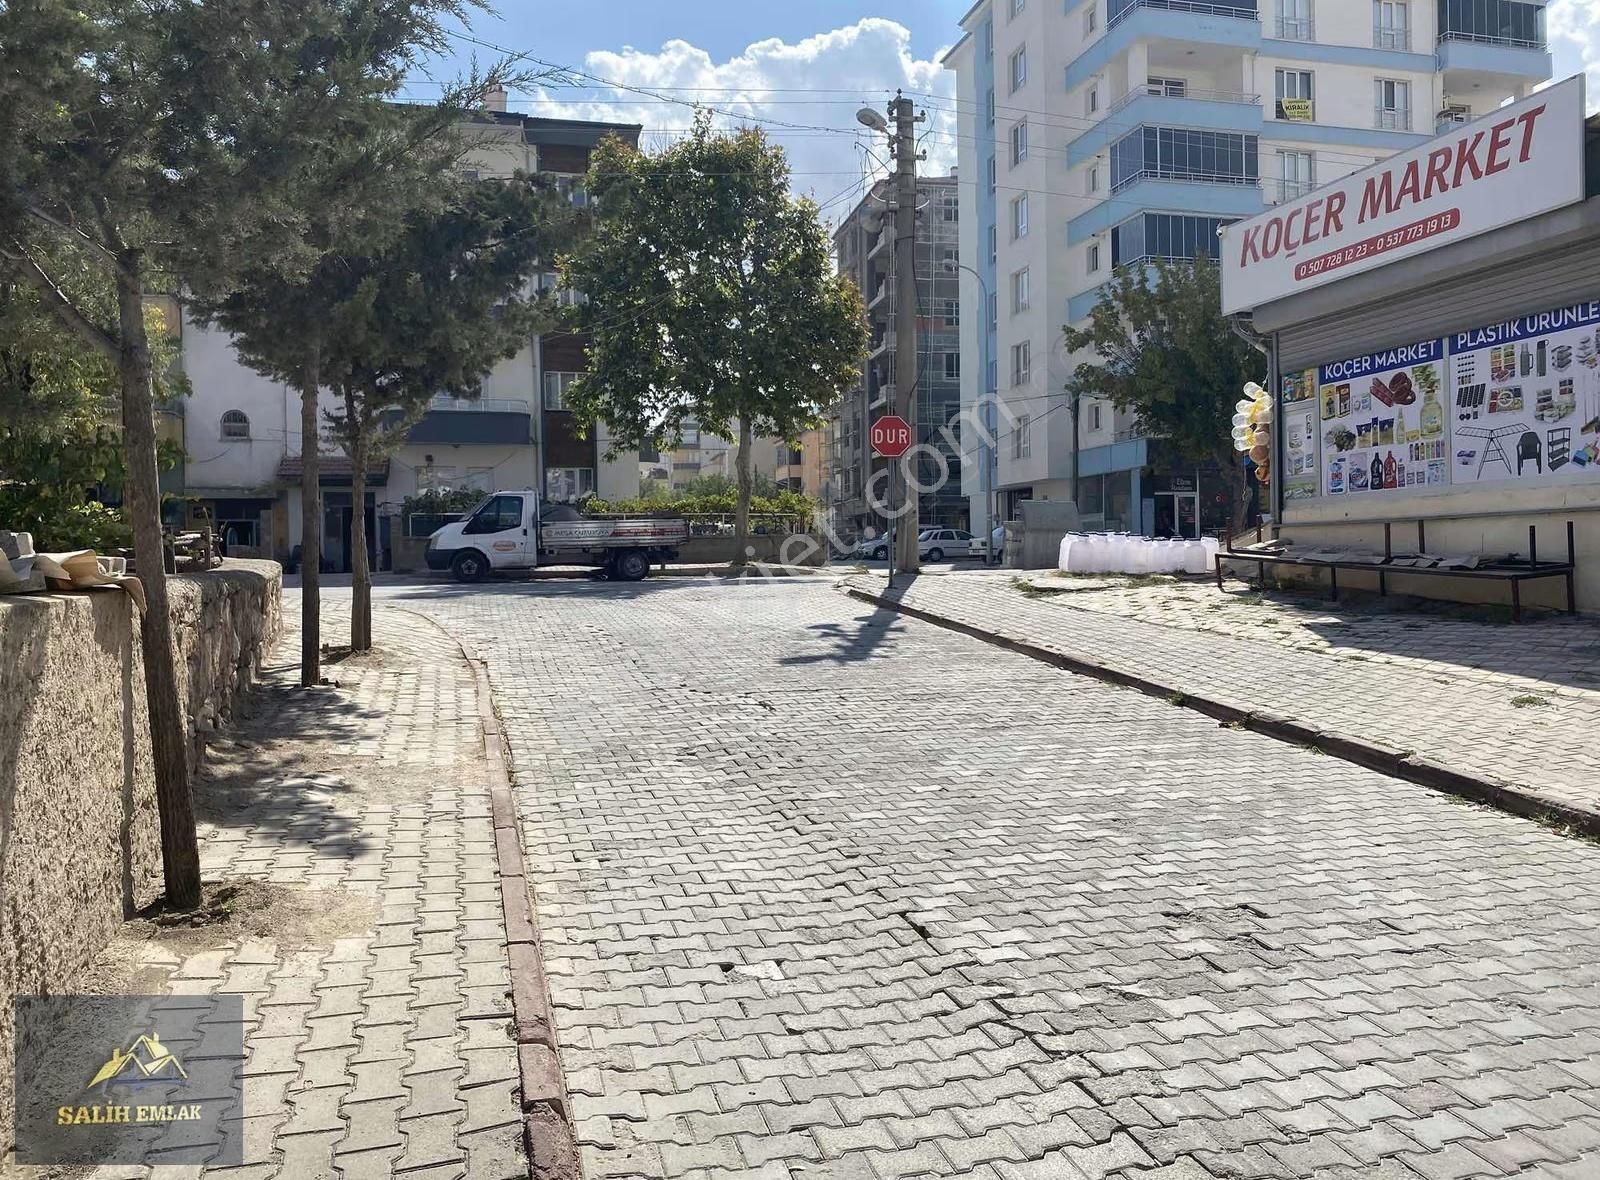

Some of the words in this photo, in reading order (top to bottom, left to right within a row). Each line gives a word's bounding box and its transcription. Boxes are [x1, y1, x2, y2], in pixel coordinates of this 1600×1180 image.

[1240, 190, 1347, 268] KOÇER
[1357, 103, 1546, 224] MARKET
[1300, 265, 1306, 276] 0
[1308, 259, 1325, 274] 507
[1326, 253, 1342, 267] 728
[1344, 249, 1353, 262] 12
[1355, 244, 1367, 257] 23
[1376, 239, 1384, 250] 0
[1386, 231, 1404, 248] 537
[1406, 225, 1423, 241] 773
[1426, 218, 1437, 233] 19
[1440, 214, 1451, 229] 13
[1325, 356, 1371, 379] KOÇER
[1374, 340, 1437, 369] MARKET
[874, 429, 908, 444] DUR
